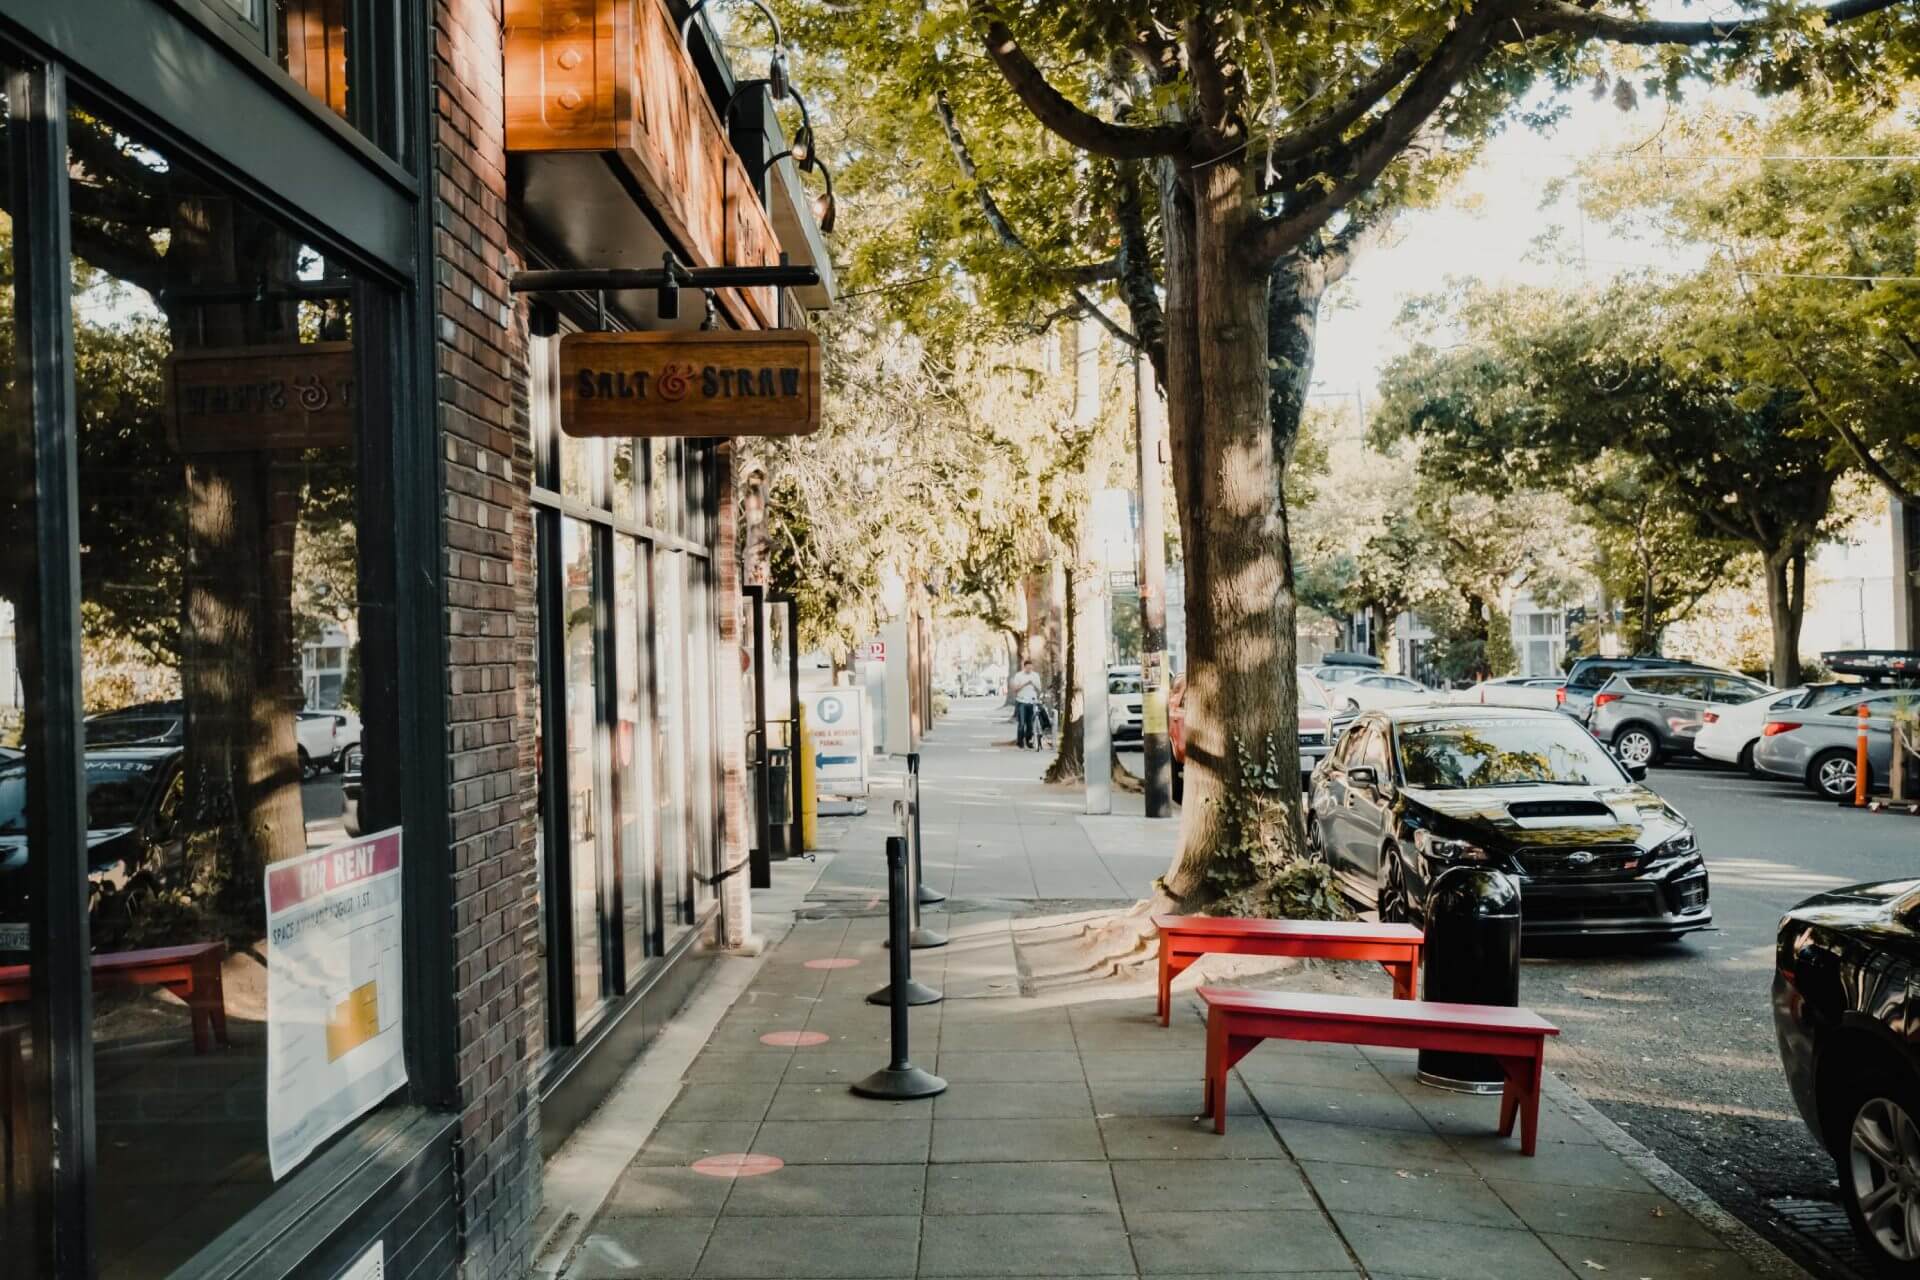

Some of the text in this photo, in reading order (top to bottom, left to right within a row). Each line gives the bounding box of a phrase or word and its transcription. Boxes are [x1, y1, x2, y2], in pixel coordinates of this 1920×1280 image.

[579, 361, 801, 401] SALT & STRAW
[299, 845, 376, 898] FOR RENT
[273, 921, 295, 945] SPACE
